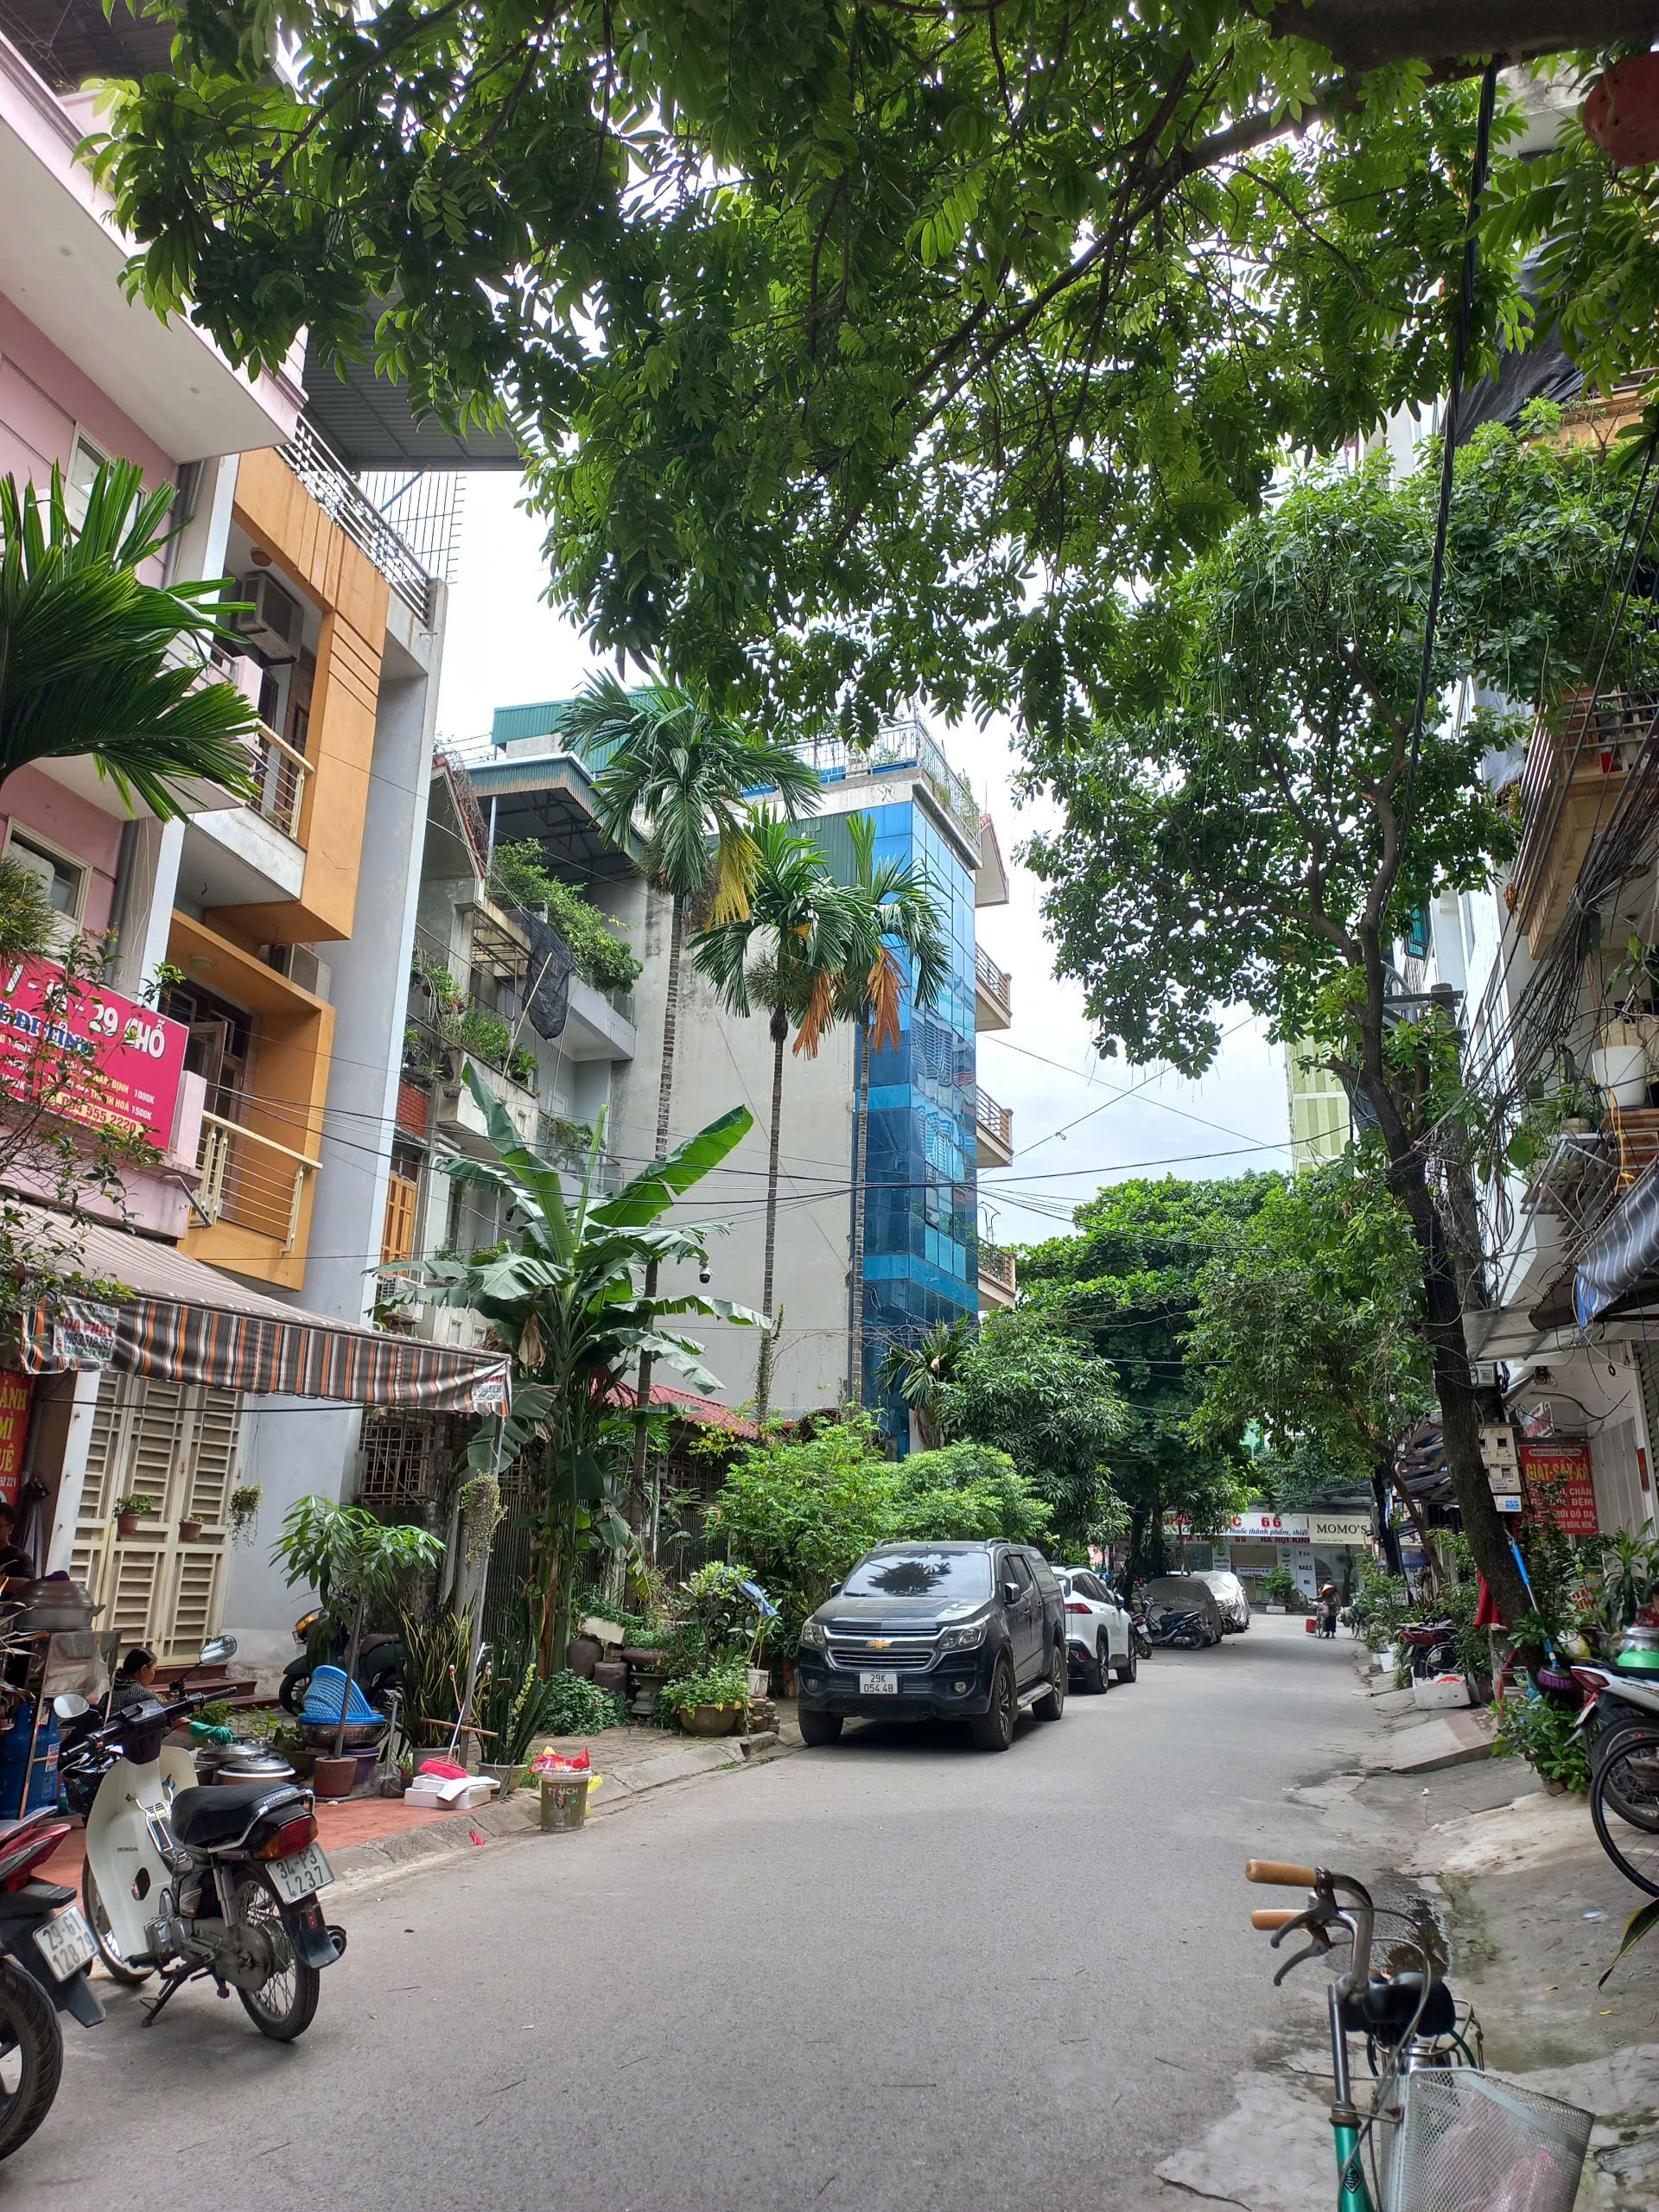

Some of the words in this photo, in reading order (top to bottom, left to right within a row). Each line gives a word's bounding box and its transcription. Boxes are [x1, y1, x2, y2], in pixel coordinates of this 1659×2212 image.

[89, 1002, 119, 1038] 29
[124, 1016, 166, 1058] CHỖ
[111, 1079, 130, 1095] ĐỊNH
[134, 1089, 156, 1105] 1000K
[86, 1106, 107, 1122] 555
[110, 1114, 137, 1133] 2220
[131, 1105, 153, 1121] 1500K
[0, 1380, 28, 1411] ÁNH
[1572, 1497, 1594, 1507] ĐỆM
[1261, 1516, 1282, 1528] 66
[863, 1683, 894, 1693] 054.48
[870, 1674, 887, 1683] 29K
[276, 1847, 317, 1879] 34-P3
[285, 1865, 324, 1898] 4237
[52, 1931, 96, 1976] 128.79
